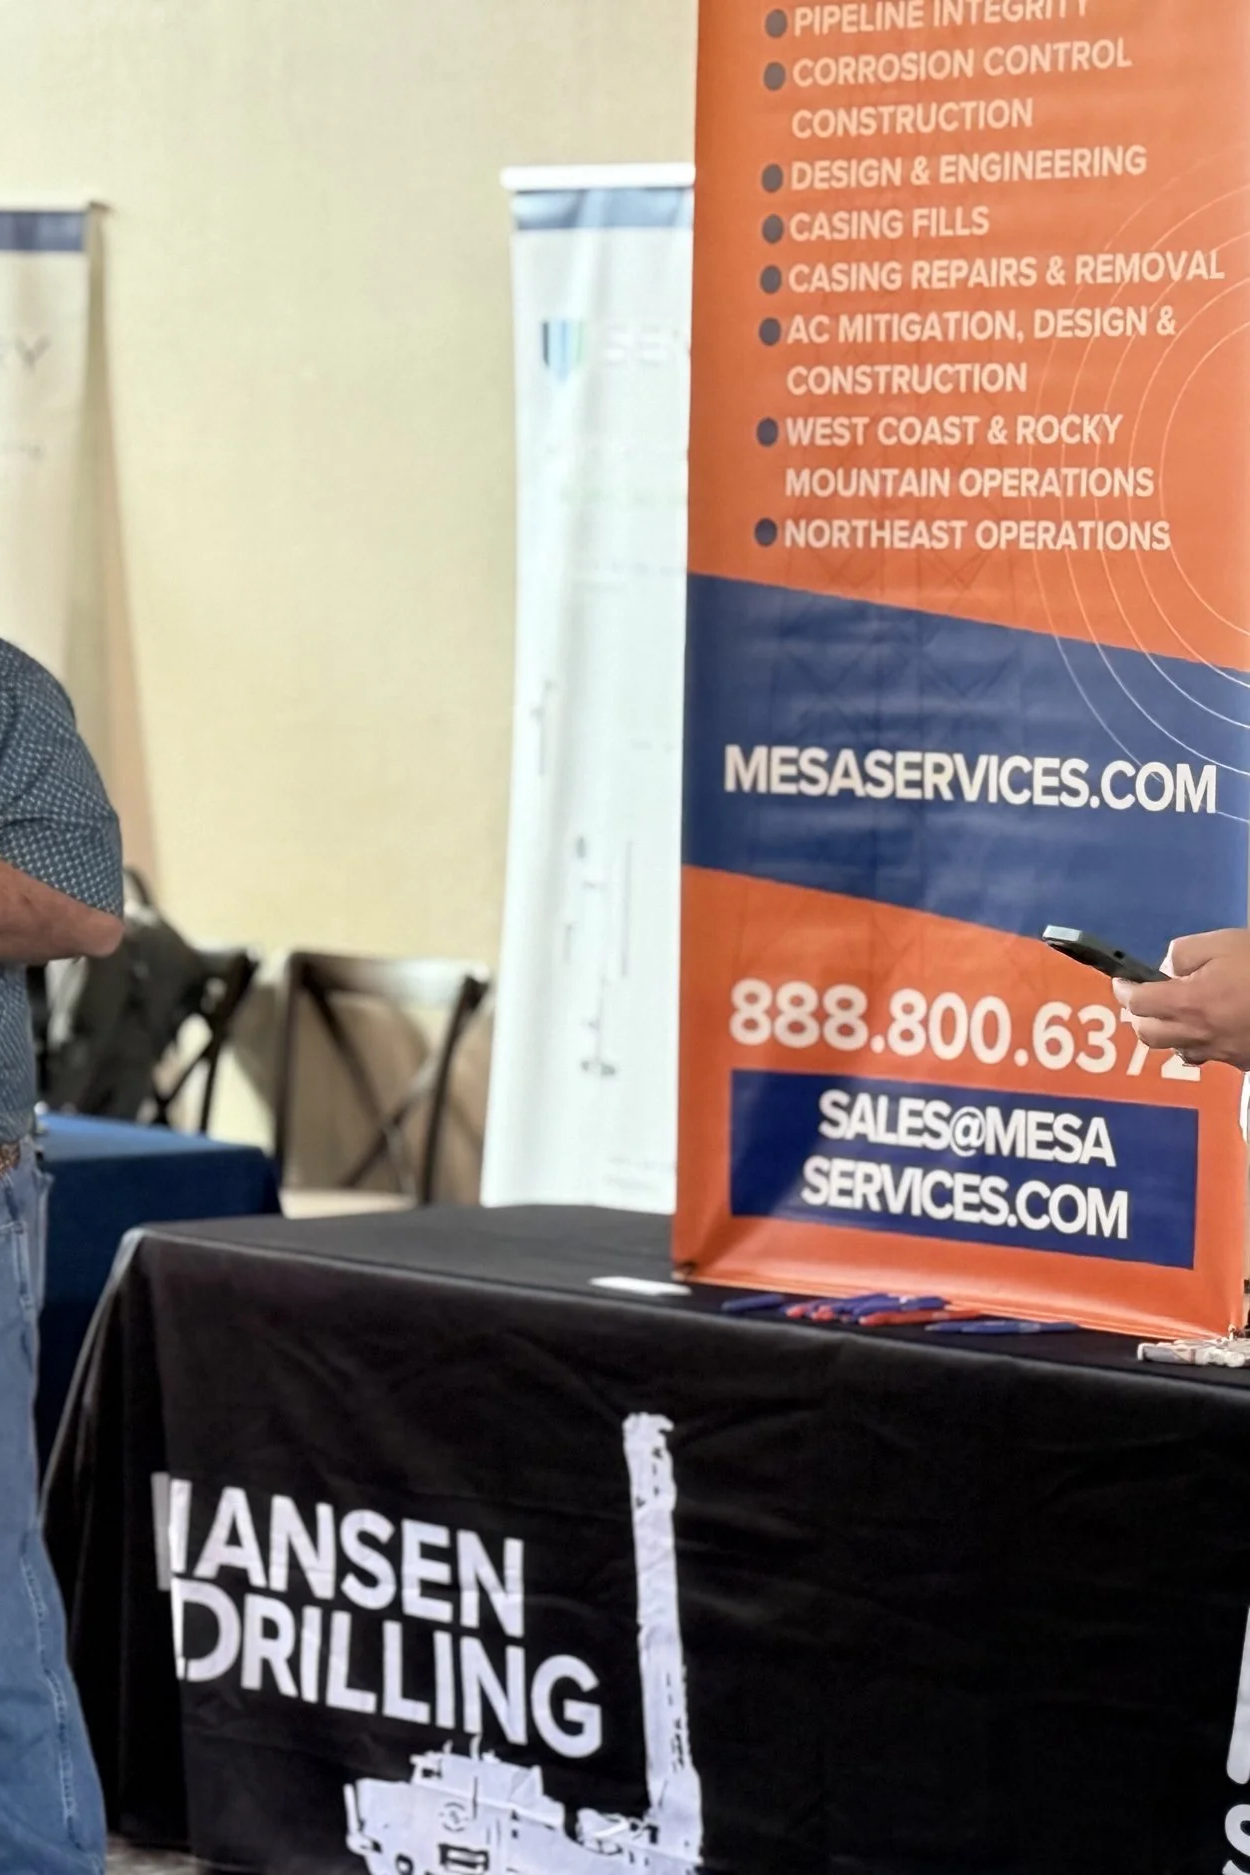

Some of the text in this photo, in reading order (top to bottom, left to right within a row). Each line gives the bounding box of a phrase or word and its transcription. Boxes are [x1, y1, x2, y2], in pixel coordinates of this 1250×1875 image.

[794, 0, 924, 36] PIPELINE
[792, 37, 1133, 87] CORROSION CONTROL
[791, 97, 1034, 139] CONSTRUCTION
[790, 144, 1148, 190] DESIGN & ENGINEERING
[788, 205, 990, 242] CASING FILLS
[788, 249, 1226, 293] CASING REPAIRS & REMOVAL
[786, 305, 1176, 344] AC MITIGATION, DESIGN &
[786, 362, 1028, 396] CONSTRUCTION
[785, 413, 1124, 446] WEST COAST & ROCKY
[785, 466, 1155, 498] MOUNTAIN OPERATIONS
[784, 519, 1173, 552] NORTHEAST OPERATIONS
[723, 744, 1218, 814] MESASERVICES.COM
[818, 1088, 1117, 1168] SALES@MESA
[801, 1156, 1129, 1240] SERVICES.COM
[170, 1577, 603, 1760] DRILLING
